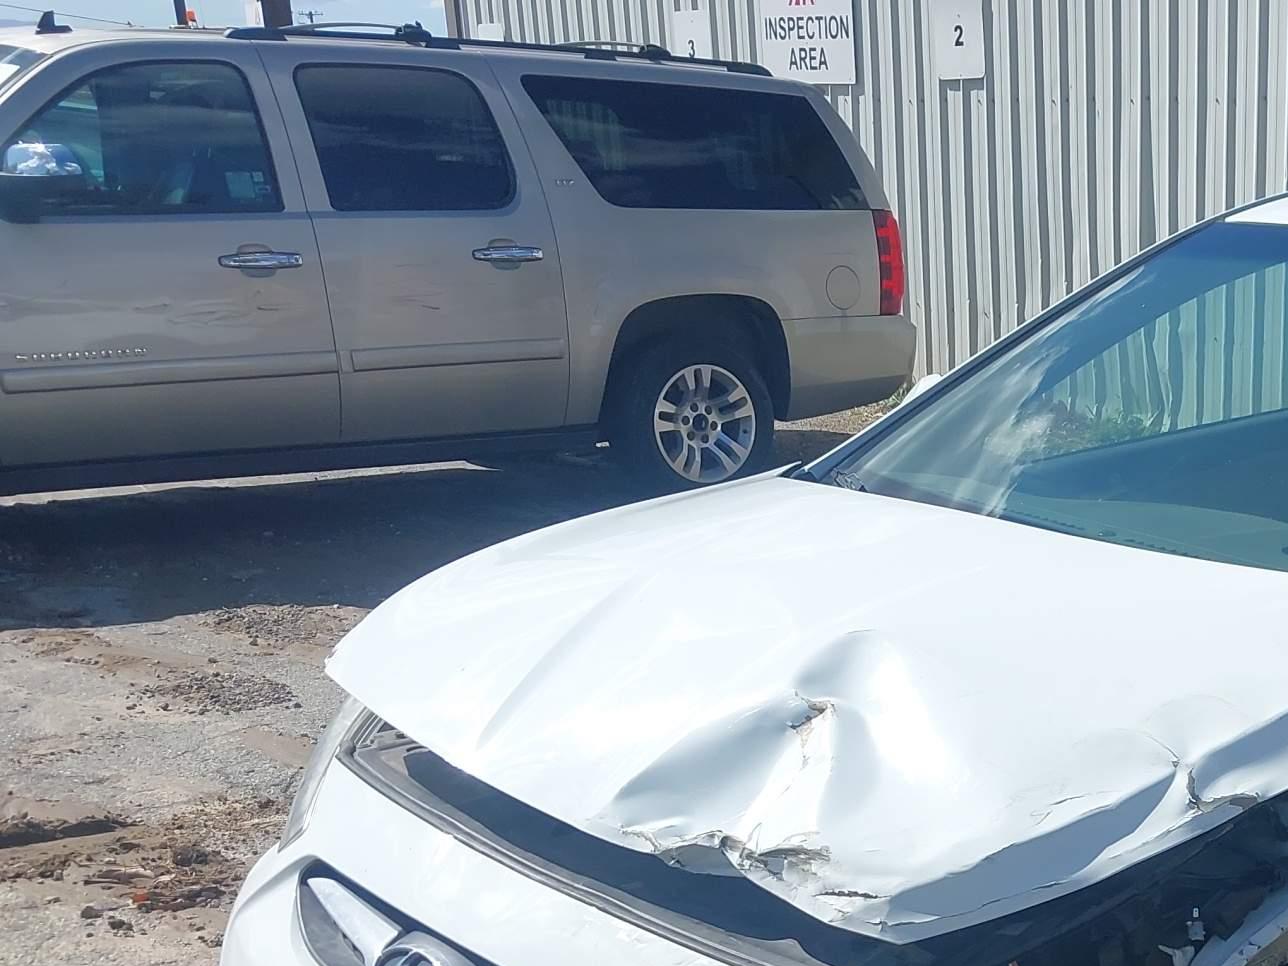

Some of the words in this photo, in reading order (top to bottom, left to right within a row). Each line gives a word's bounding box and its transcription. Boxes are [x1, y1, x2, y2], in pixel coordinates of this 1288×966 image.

[764, 15, 850, 40] INSPECTION
[954, 25, 964, 46] 2
[688, 39, 696, 58] 3
[788, 47, 829, 71] AREA
